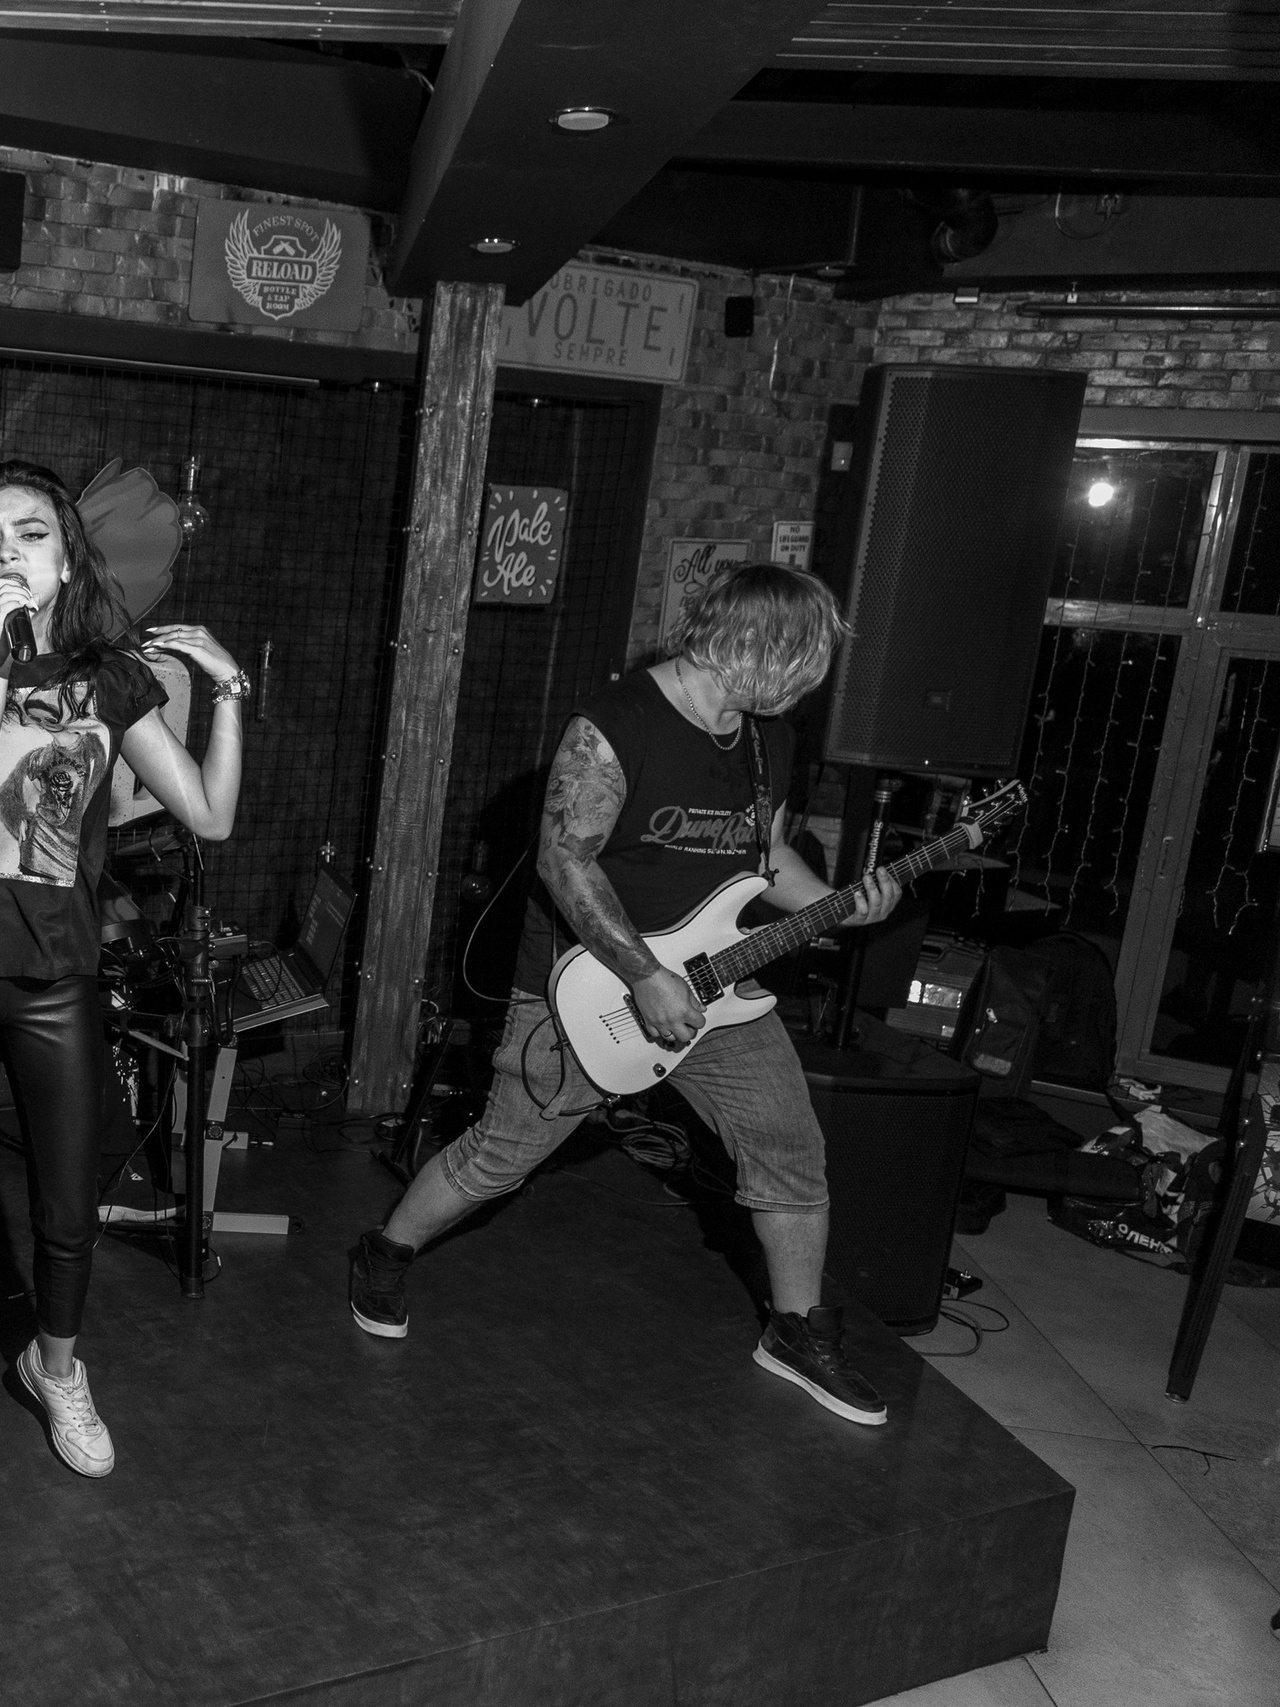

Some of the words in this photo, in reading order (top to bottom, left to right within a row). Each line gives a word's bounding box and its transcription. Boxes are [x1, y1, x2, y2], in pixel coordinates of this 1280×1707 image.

[252, 216, 294, 237] FINEST
[294, 217, 319, 242] SPOT
[251, 259, 313, 281] RELOAD
[263, 285, 297, 295] BOTTLE
[550, 273, 652, 302] OBRIGADO
[266, 302, 290, 310] ROOM
[527, 292, 668, 352] VOLTE
[554, 342, 628, 366] SEMPRE
[487, 501, 552, 562] Pale
[483, 551, 535, 595] Ale
[673, 544, 716, 584] All
